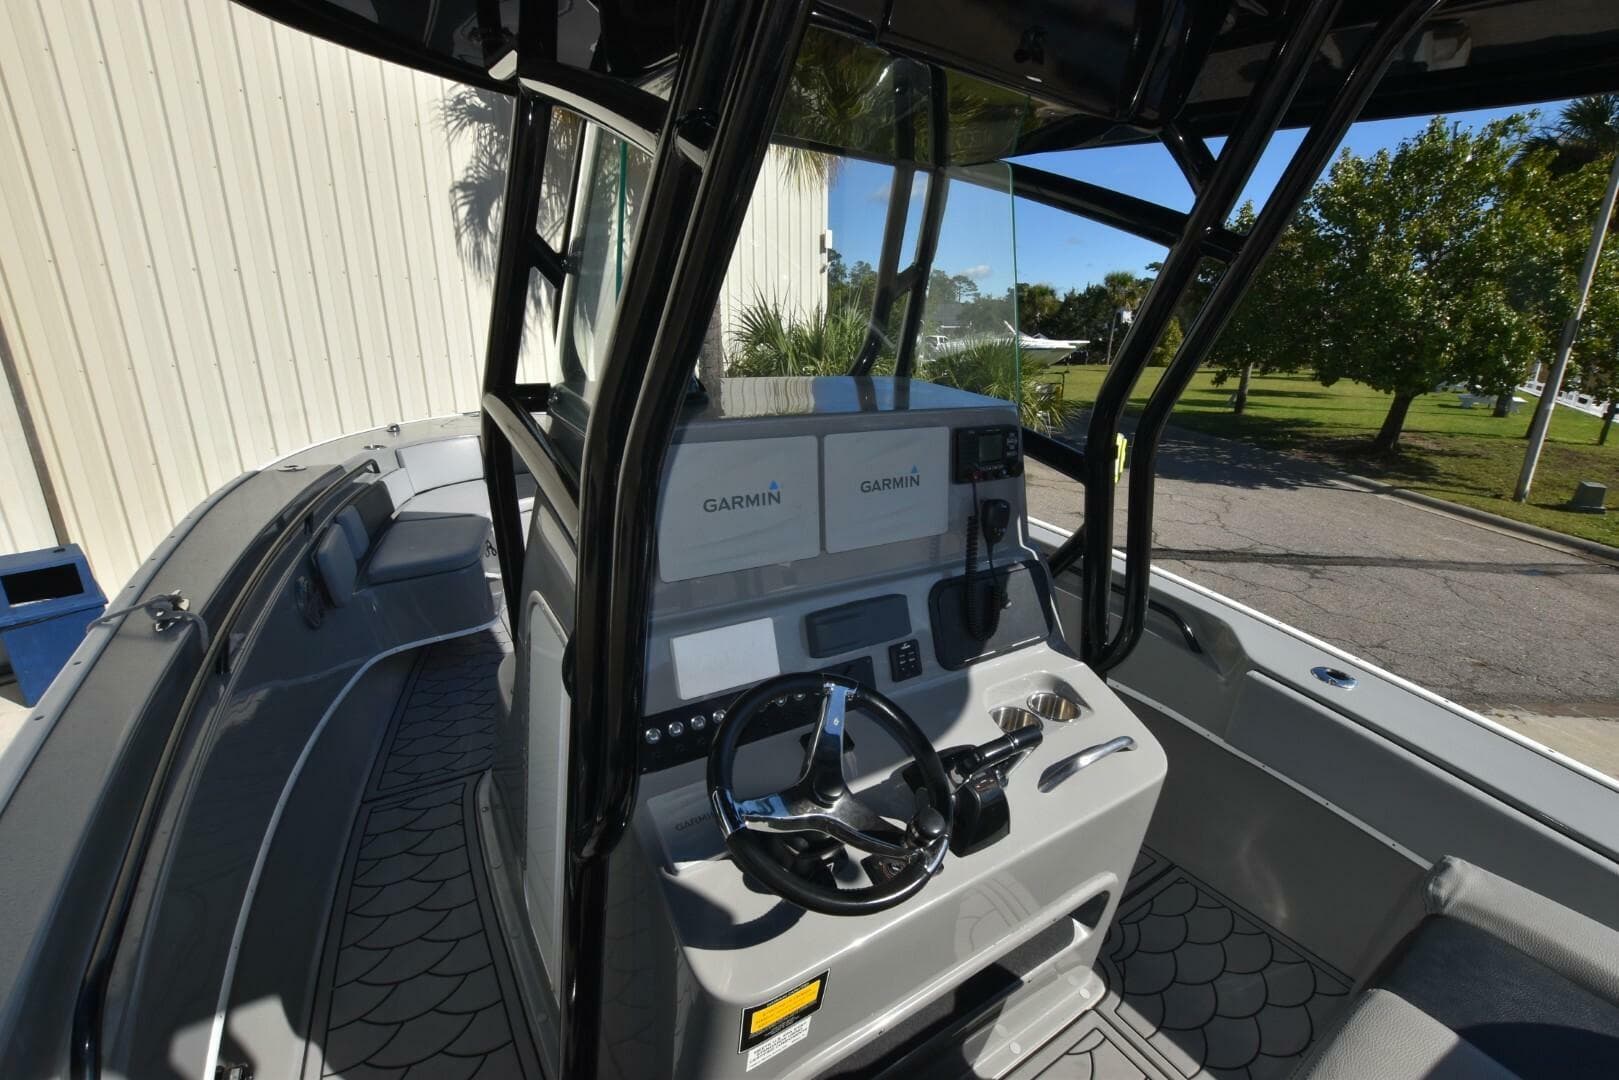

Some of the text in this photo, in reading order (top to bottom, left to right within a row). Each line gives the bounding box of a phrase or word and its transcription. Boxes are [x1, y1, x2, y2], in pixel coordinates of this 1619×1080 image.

[860, 474, 920, 493] GARMIN
[703, 490, 781, 513] GARMIN
[675, 810, 714, 831] GARMI
